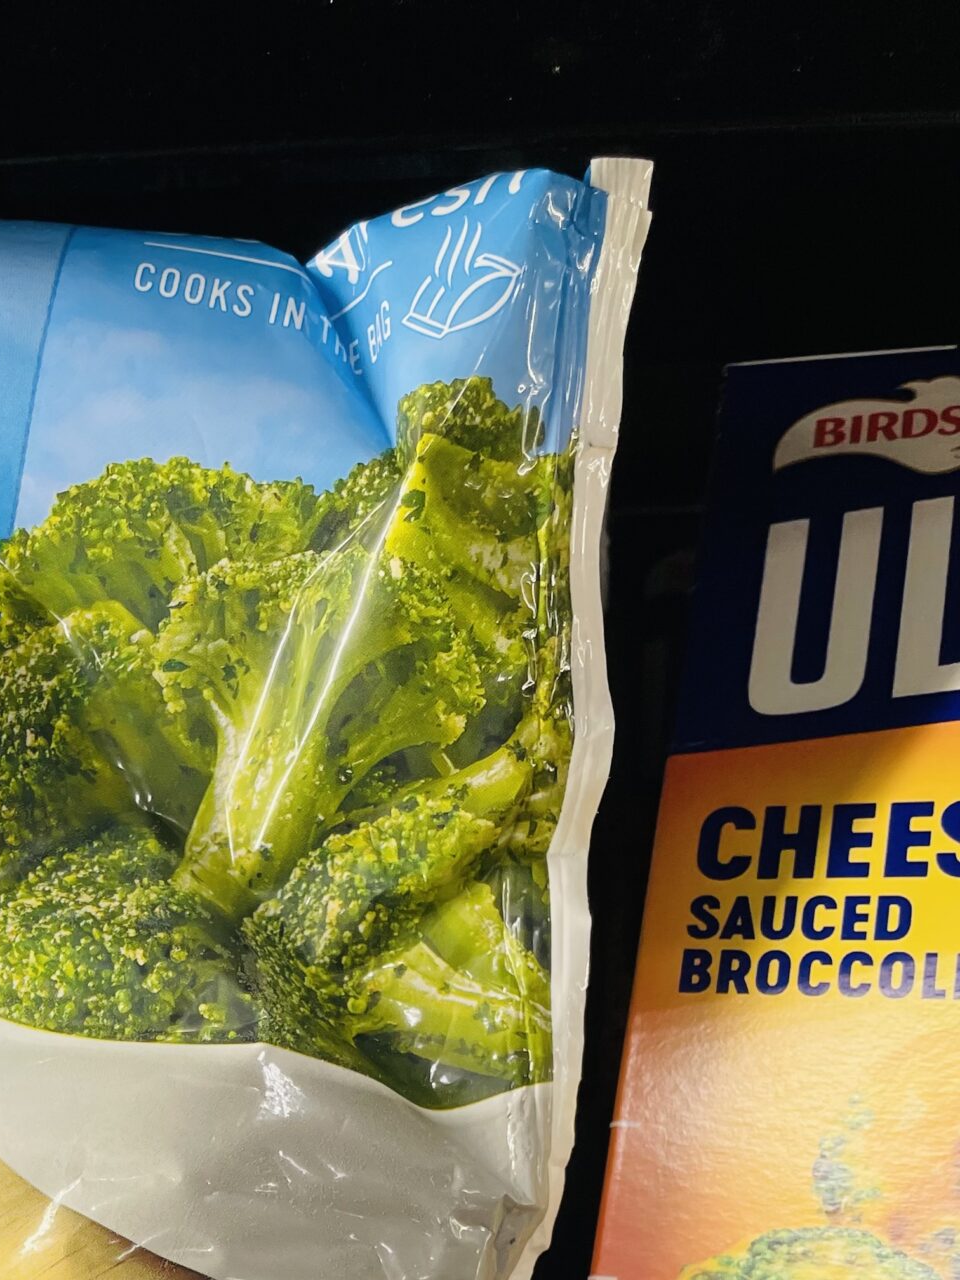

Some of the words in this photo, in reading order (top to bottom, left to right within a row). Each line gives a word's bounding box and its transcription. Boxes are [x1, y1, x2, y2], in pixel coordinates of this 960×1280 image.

[134, 261, 252, 318] COOKS
[268, 290, 307, 331] IN
[812, 405, 960, 449] BIRDS
[686, 895, 913, 941] SAUCED
